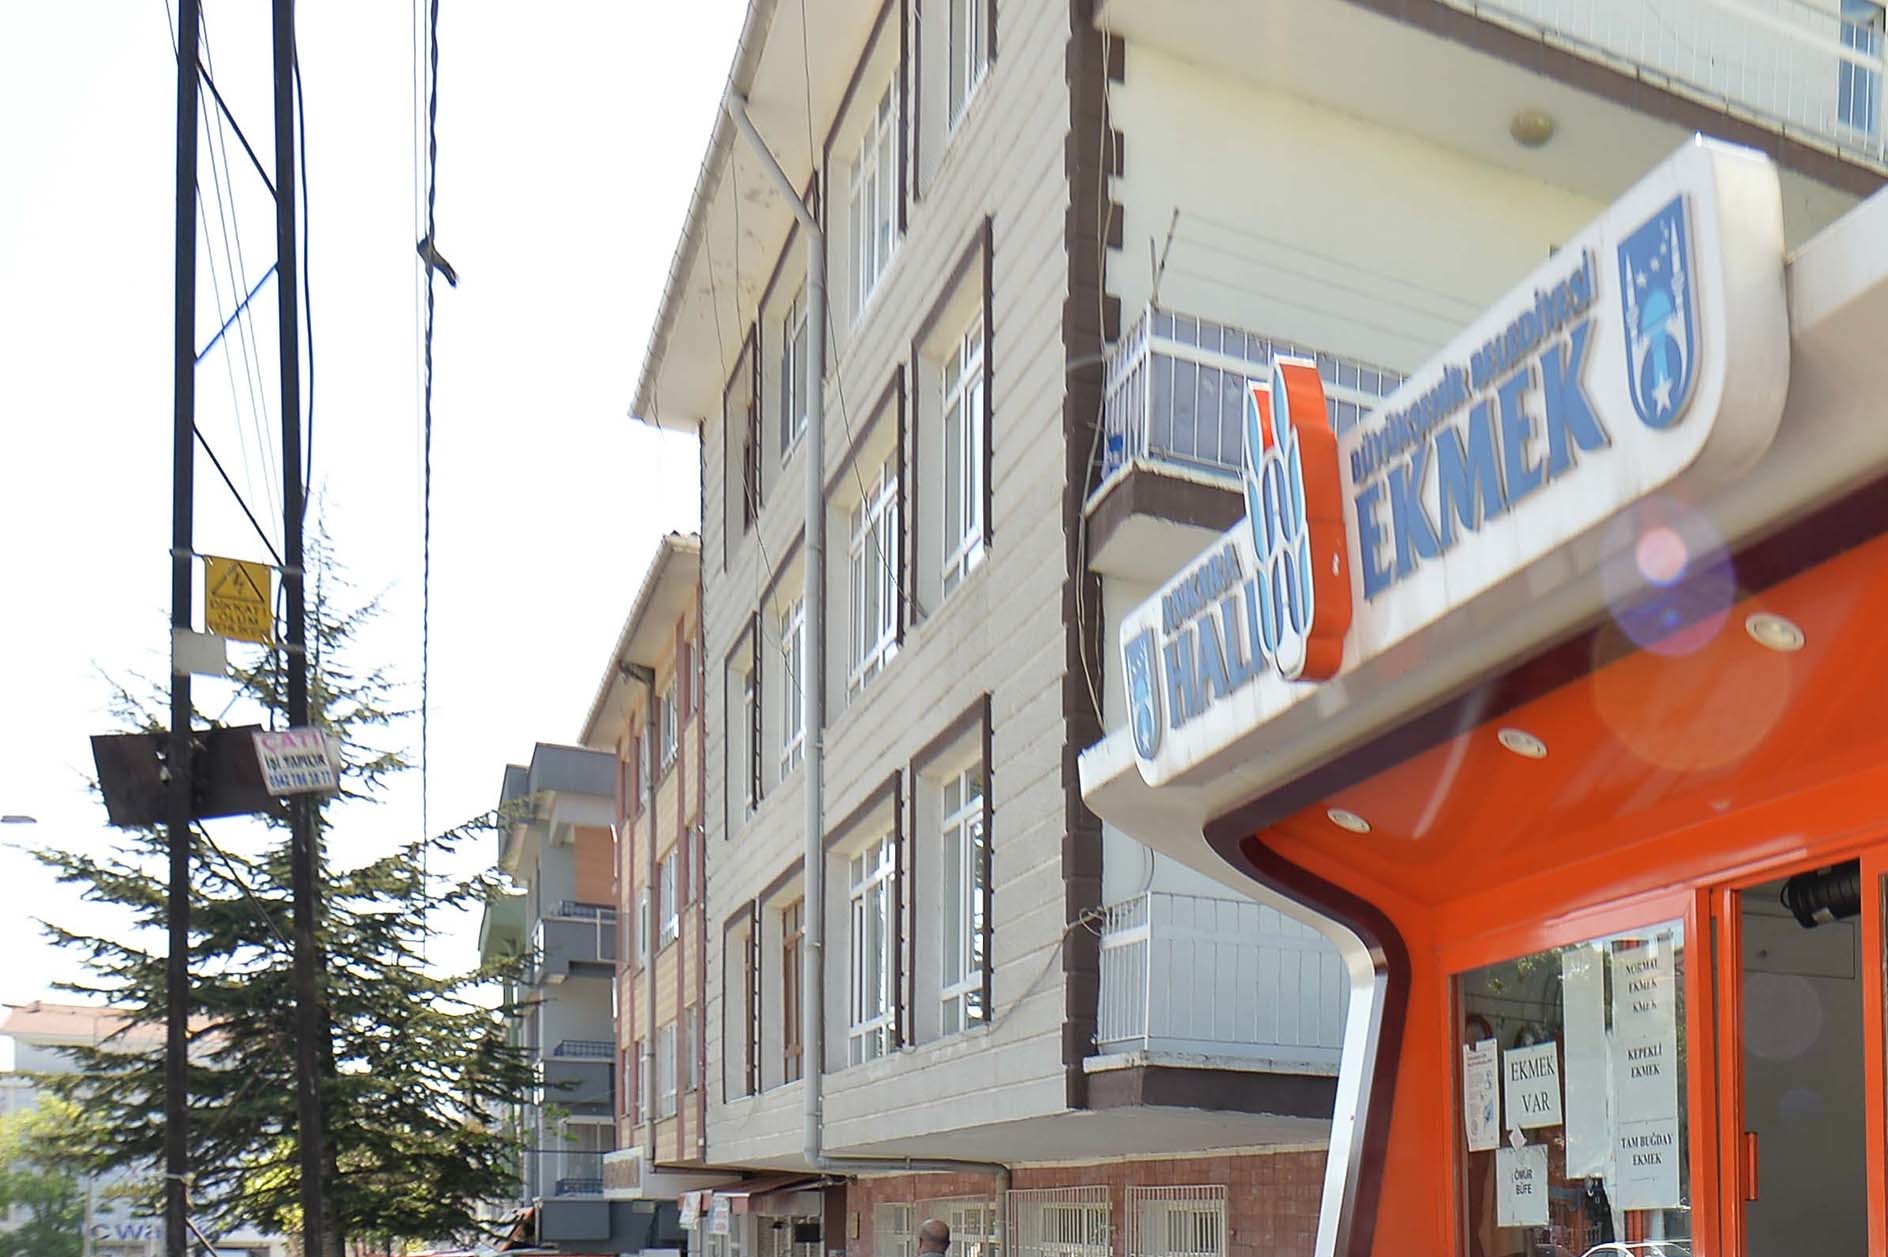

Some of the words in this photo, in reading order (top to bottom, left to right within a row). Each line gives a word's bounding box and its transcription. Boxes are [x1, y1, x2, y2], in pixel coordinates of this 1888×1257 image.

[1355, 318, 1611, 600] EKMEK
[1162, 543, 1242, 637] ANKARA
[1628, 1041, 1663, 1061] KEPEKLİ
[1511, 1055, 1555, 1082] EKMEK
[1631, 1063, 1660, 1079] EKMEK
[1521, 1090, 1551, 1113] VAR
[1621, 1136, 1639, 1150] TAM
[1640, 1132, 1673, 1148] BUĞDAY
[1632, 1153, 1662, 1167] EKMEK
[1513, 1168, 1533, 1181] ÖMÜR
[1515, 1182, 1533, 1195] BÜFE
